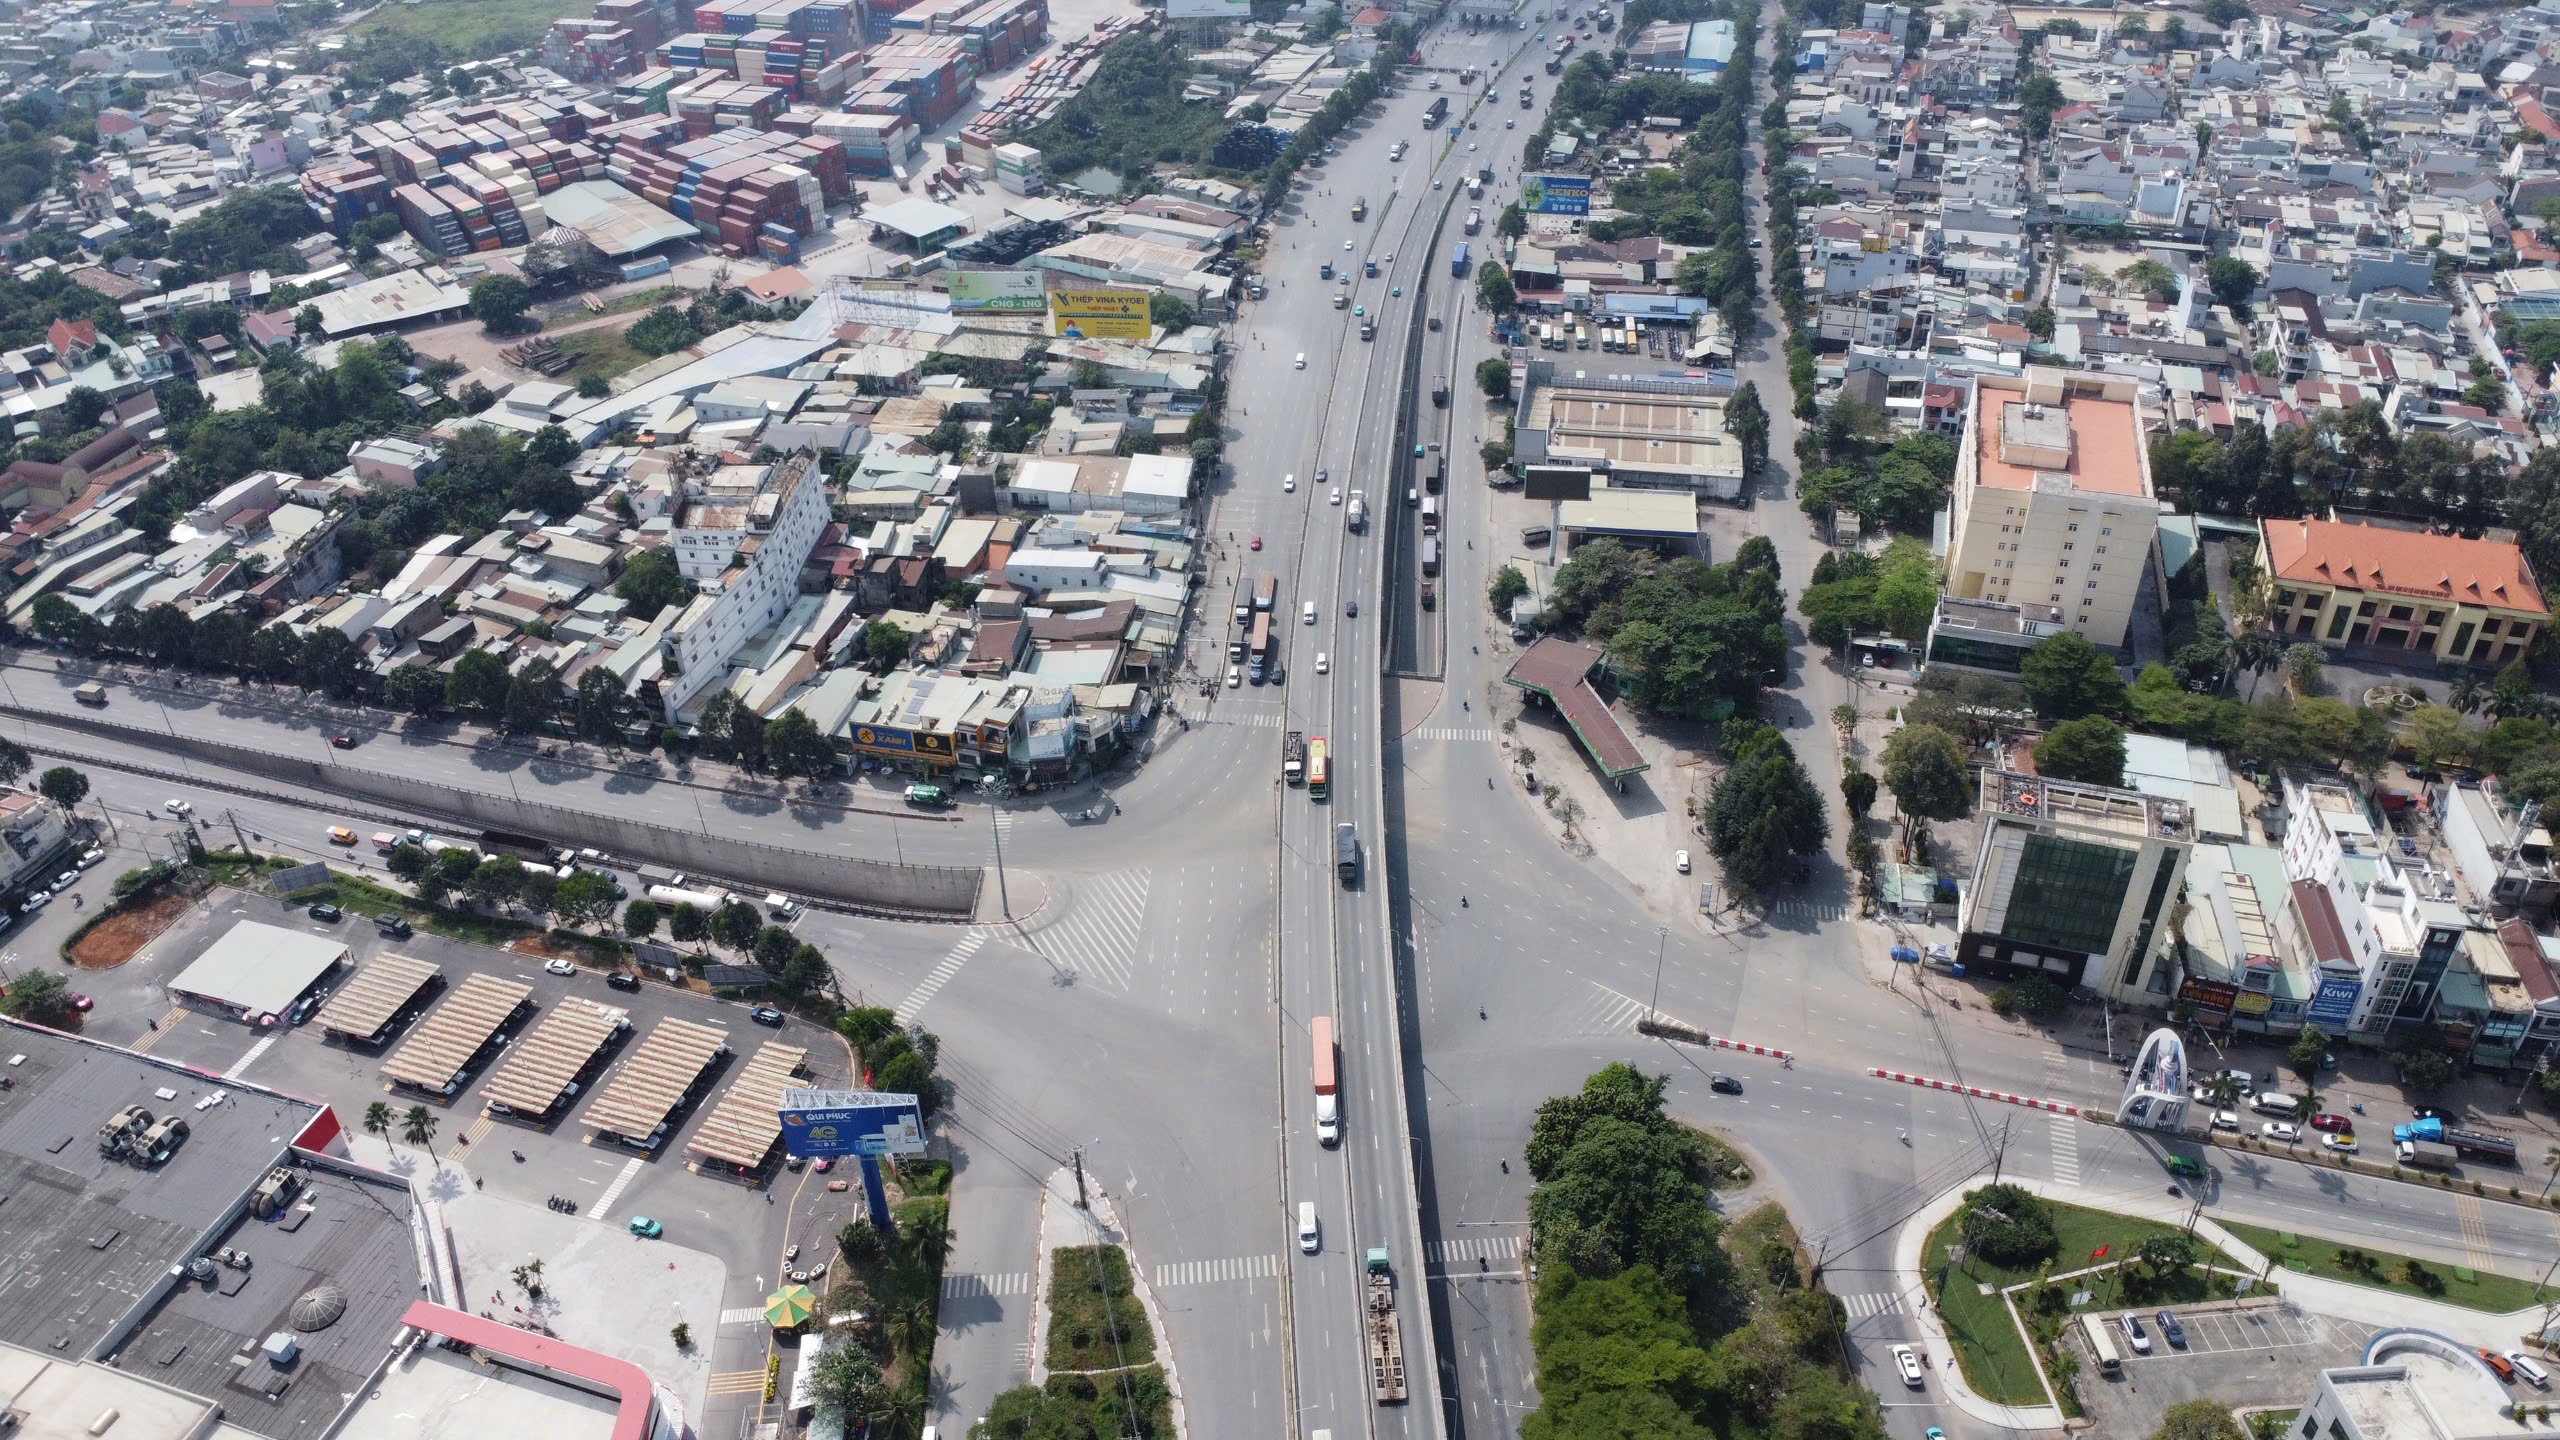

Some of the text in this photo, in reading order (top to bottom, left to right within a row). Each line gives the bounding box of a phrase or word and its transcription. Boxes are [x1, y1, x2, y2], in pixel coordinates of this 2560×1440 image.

[1548, 188, 1589, 197] SENKO
[991, 300, 1014, 308] CNG
[1022, 300, 1042, 308] LNG
[1095, 296, 1115, 304] VINA
[1117, 297, 1145, 305] KYOEI
[879, 735, 906, 745] XANH
[806, 1113, 825, 1121] QUI
